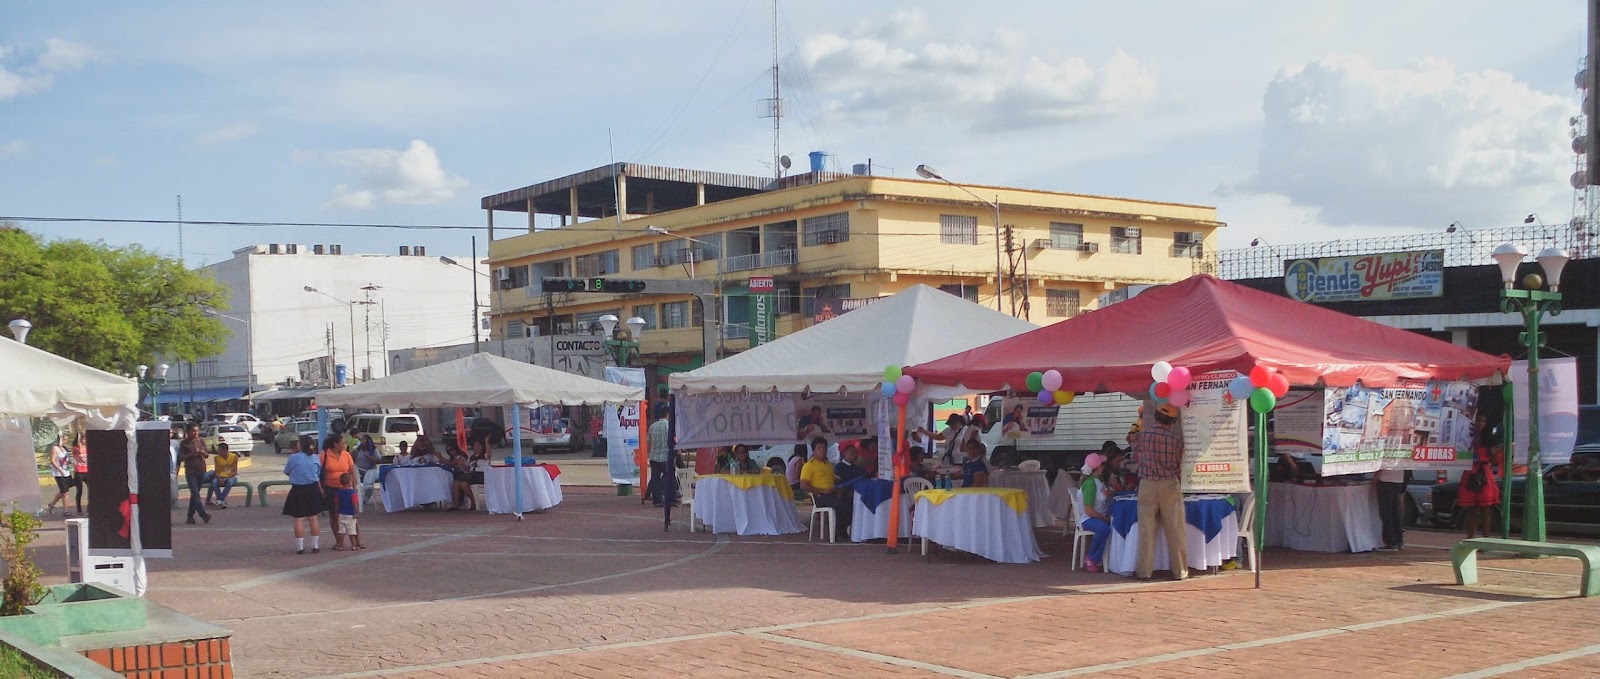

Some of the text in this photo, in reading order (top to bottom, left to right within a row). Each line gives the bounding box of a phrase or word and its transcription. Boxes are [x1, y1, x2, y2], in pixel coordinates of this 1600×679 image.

[1354, 252, 1412, 297] Yupi
[595, 279, 602, 289] 8
[749, 279, 773, 288] ABIERTO
[556, 340, 600, 351] CONTACTO
[1380, 390, 1427, 401] SAN FERNANDO
[1414, 447, 1425, 460] 24
[1427, 448, 1454, 460] HORAS
[1206, 464, 1229, 472] HORAS
